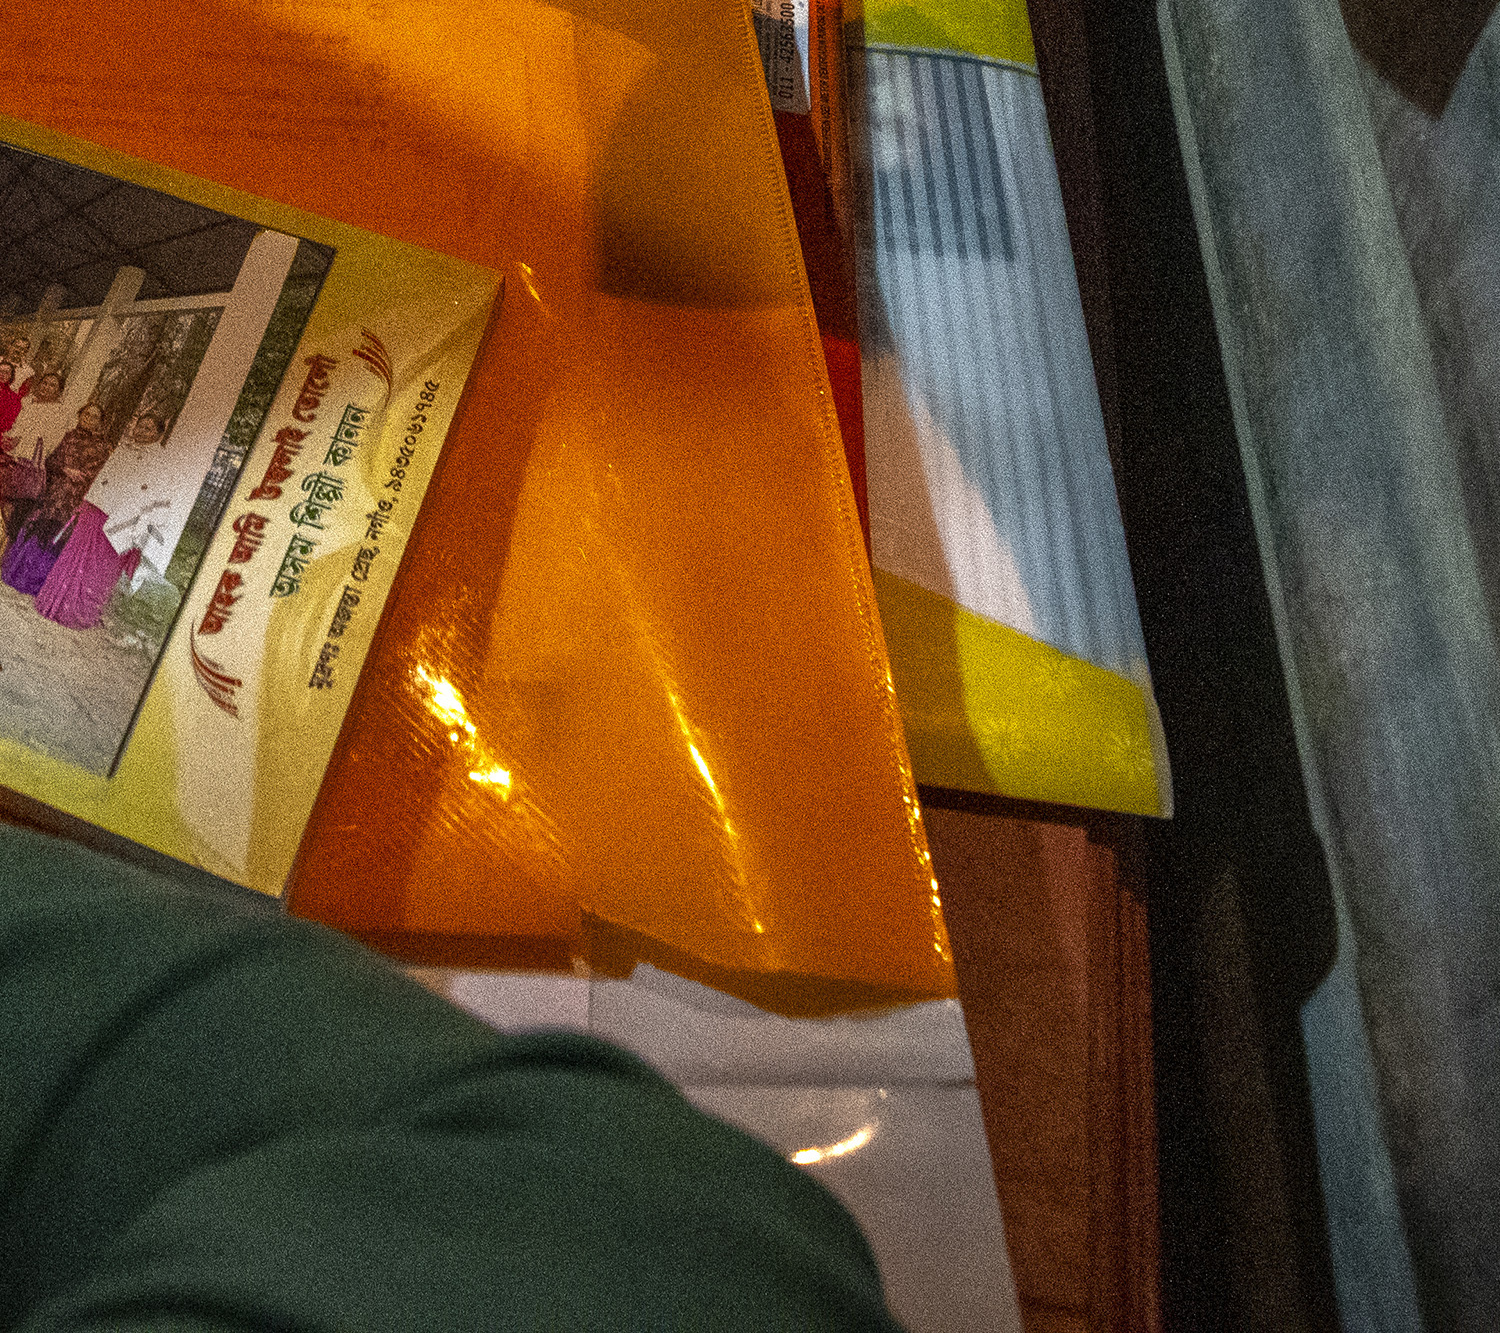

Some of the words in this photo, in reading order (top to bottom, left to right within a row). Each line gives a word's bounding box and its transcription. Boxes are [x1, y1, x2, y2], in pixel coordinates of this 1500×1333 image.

[321, 403, 372, 469] কানন
[287, 467, 344, 533] শিল্পী
[219, 508, 269, 568] আমি
[266, 535, 318, 603] অসম
